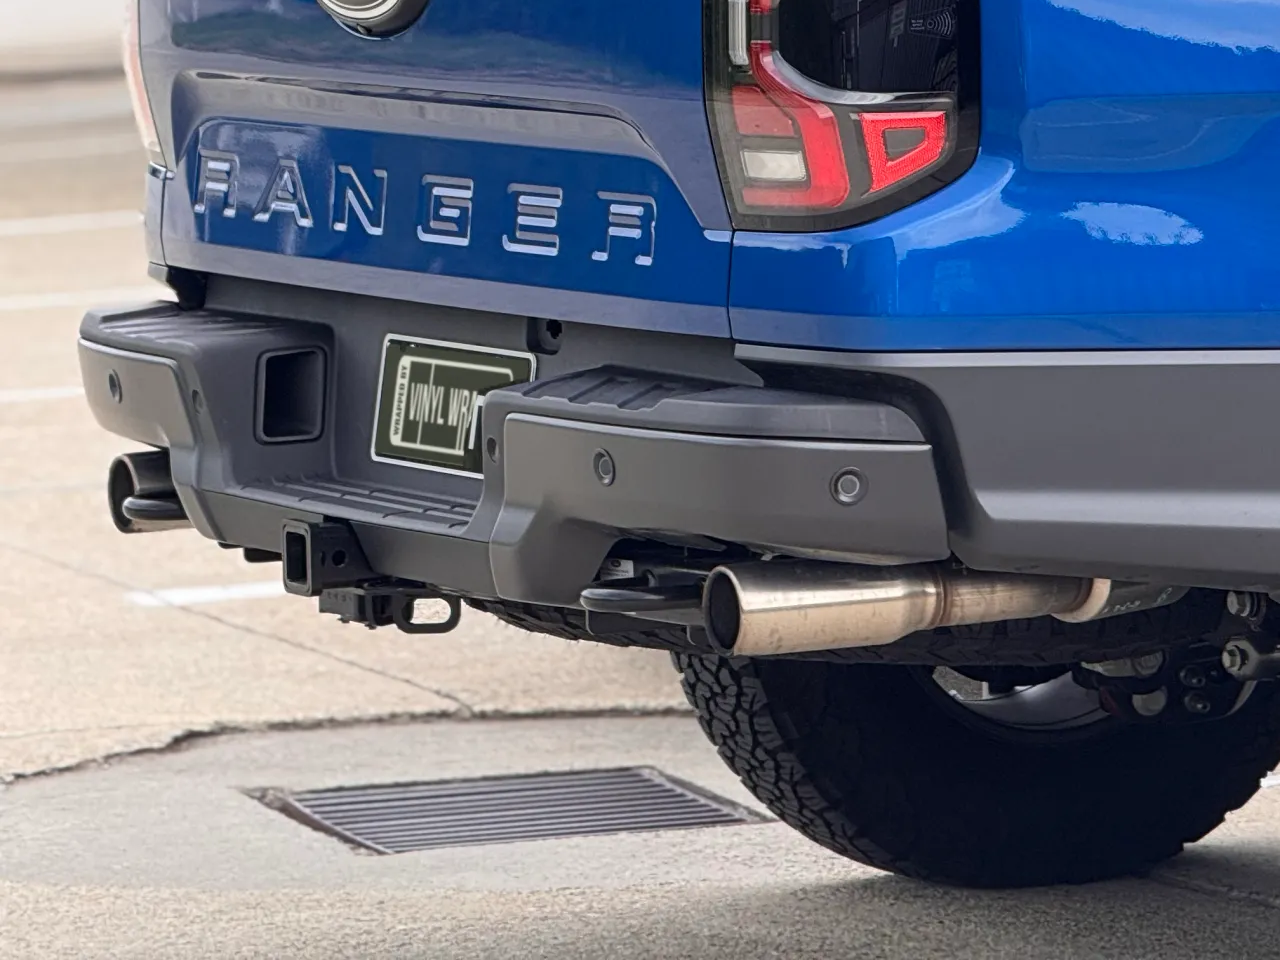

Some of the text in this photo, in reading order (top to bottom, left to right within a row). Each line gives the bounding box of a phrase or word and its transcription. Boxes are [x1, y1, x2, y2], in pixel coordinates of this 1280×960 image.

[193, 148, 658, 267] RANGER
[392, 365, 409, 436] WRAPPED BY
[409, 382, 478, 429] VINYL WRA
